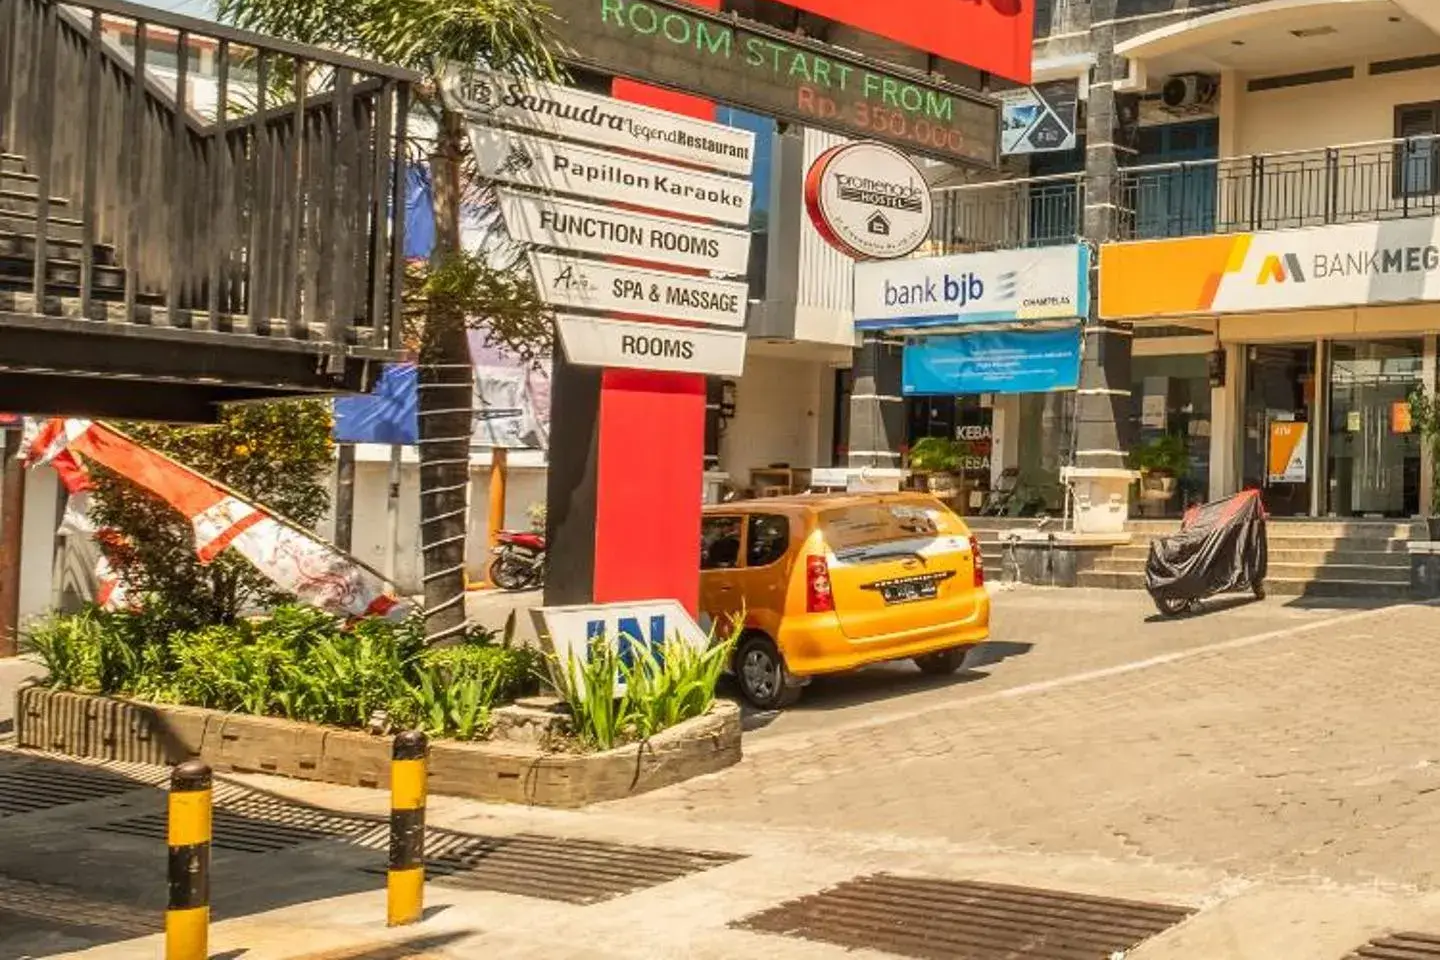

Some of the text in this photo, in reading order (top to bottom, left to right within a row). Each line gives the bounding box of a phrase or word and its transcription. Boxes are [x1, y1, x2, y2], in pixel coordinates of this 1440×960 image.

[745, 39, 854, 90] START
[863, 74, 953, 121] FROM
[503, 83, 625, 131] Samudra
[677, 130, 750, 159] Restaurant
[553, 155, 744, 208] Papillon Karaoke
[834, 173, 922, 198] promenade
[861, 192, 905, 208] HOSTEL
[540, 211, 720, 258] FUNCTION ROOMS
[612, 277, 644, 301] SPA
[649, 283, 661, 303] &
[665, 286, 738, 313] MASSAGE
[884, 272, 984, 307] bank bjb
[621, 335, 694, 360] ROOMS
[955, 425, 992, 440] KEBA
[957, 455, 991, 470] EBA
